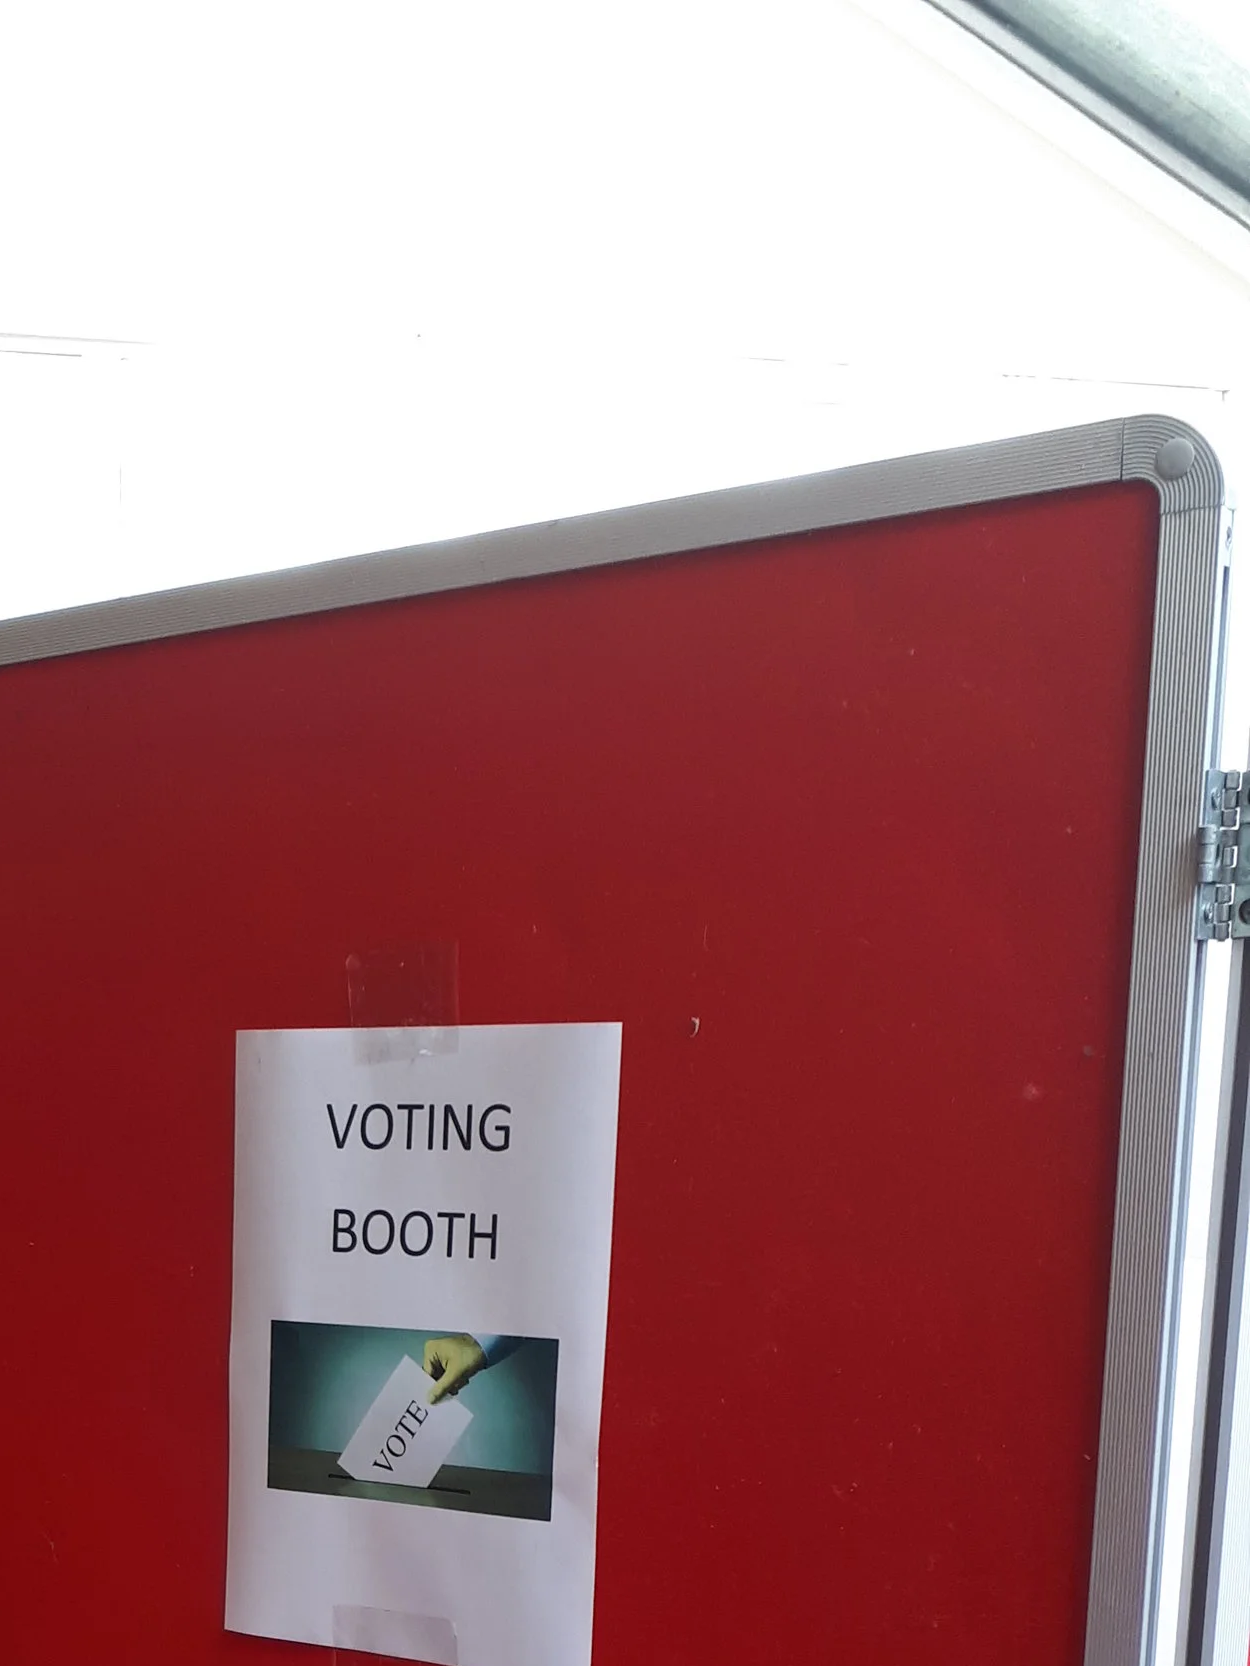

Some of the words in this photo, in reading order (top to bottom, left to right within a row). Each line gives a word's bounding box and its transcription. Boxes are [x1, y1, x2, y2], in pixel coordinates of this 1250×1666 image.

[326, 1103, 512, 1152] VOTING
[332, 1208, 498, 1260] BOOTH
[372, 1399, 429, 1472] VOTE
